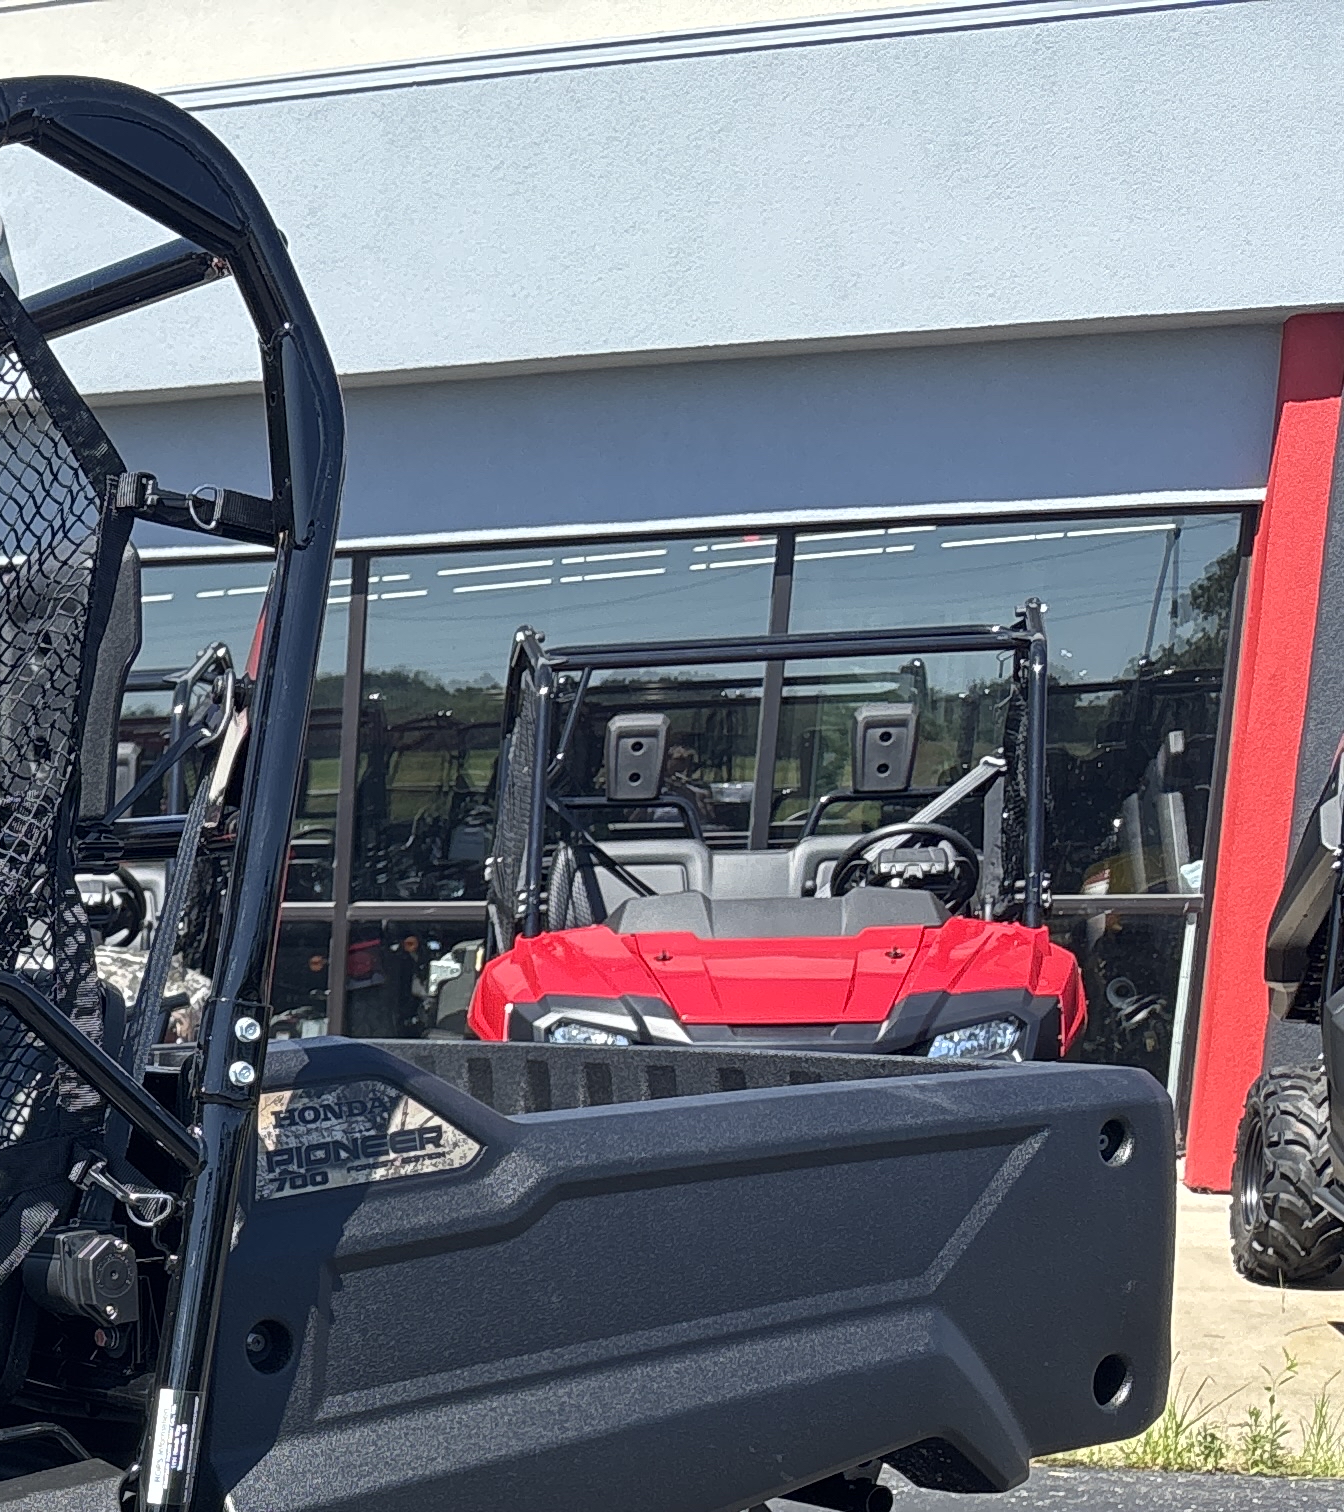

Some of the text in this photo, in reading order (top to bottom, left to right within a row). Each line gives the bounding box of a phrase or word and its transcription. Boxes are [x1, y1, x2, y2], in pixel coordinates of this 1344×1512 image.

[271, 1098, 390, 1129] HONDA
[266, 1124, 443, 1173] PIONEER
[269, 1171, 329, 1192] 700
